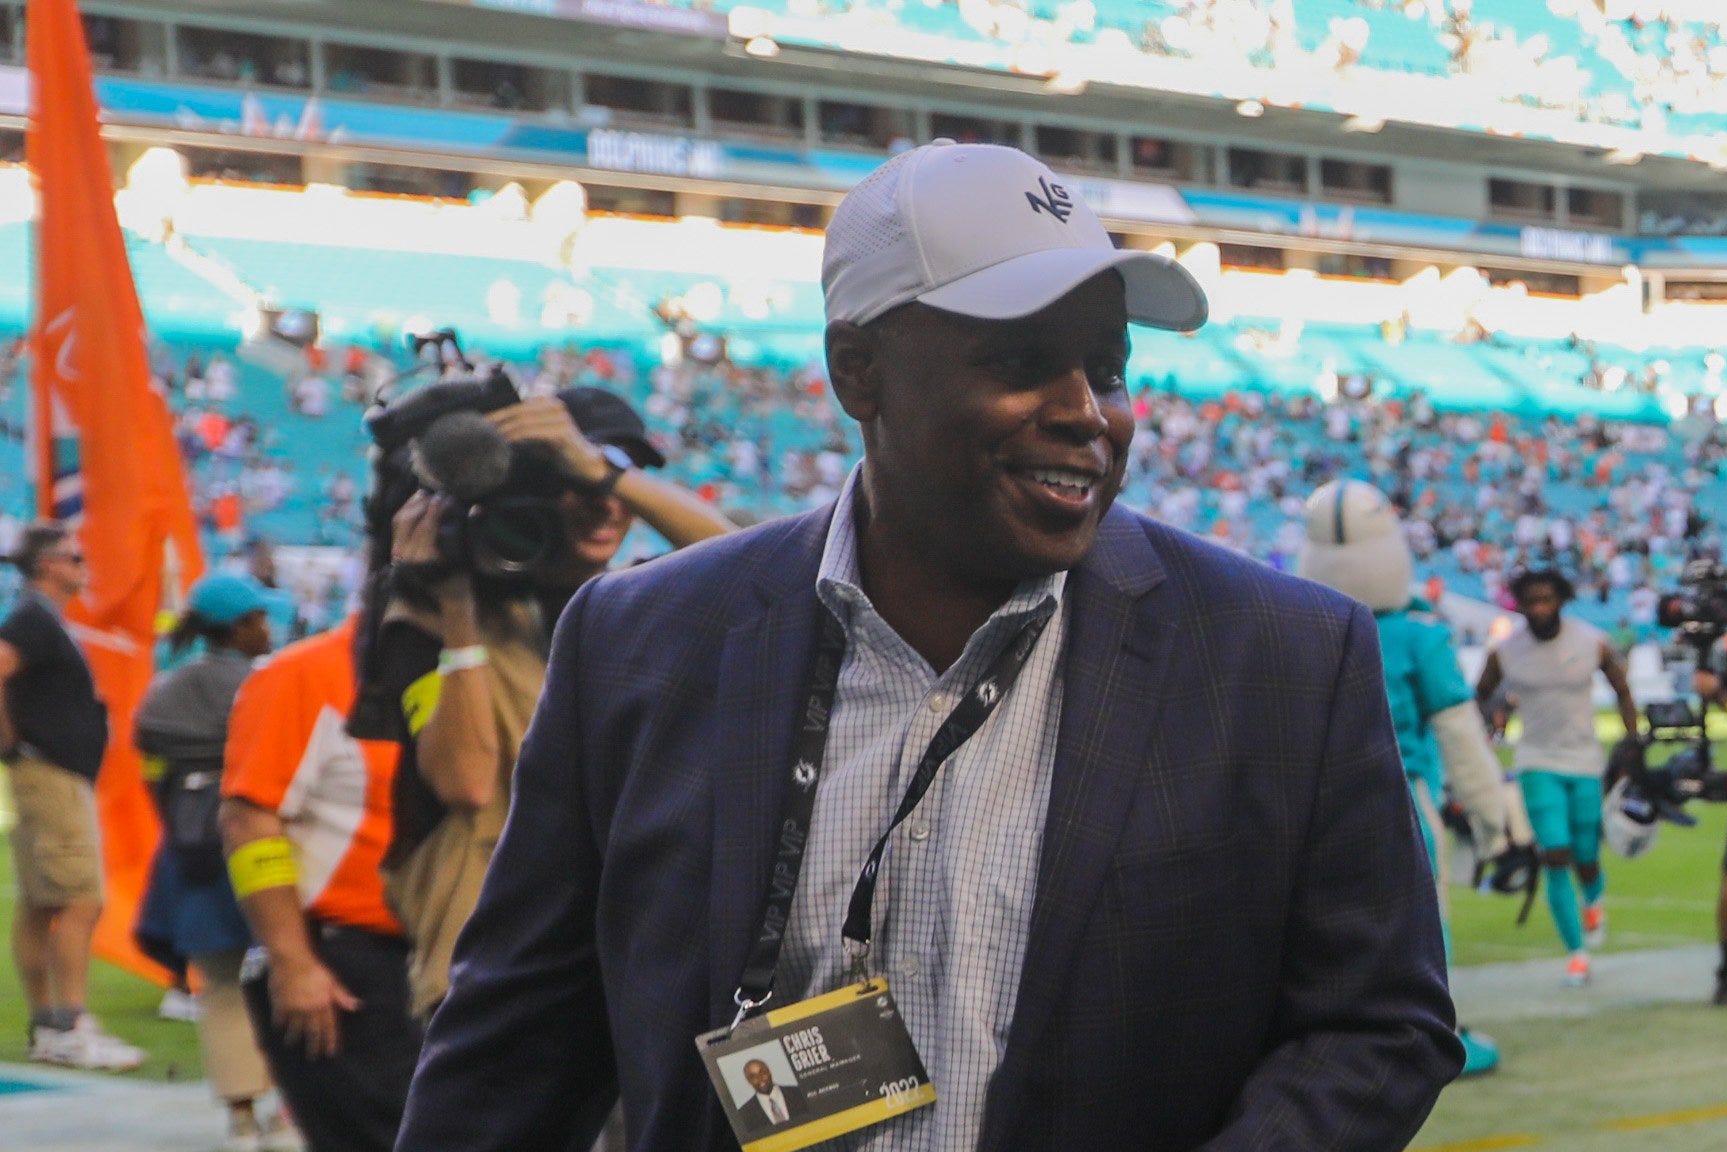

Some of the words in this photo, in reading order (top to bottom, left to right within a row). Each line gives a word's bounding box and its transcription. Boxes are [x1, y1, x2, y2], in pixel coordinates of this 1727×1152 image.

[783, 1025, 824, 1054] CHRIS
[790, 1044, 832, 1072] GRIER
[878, 1073, 921, 1110] 2022
